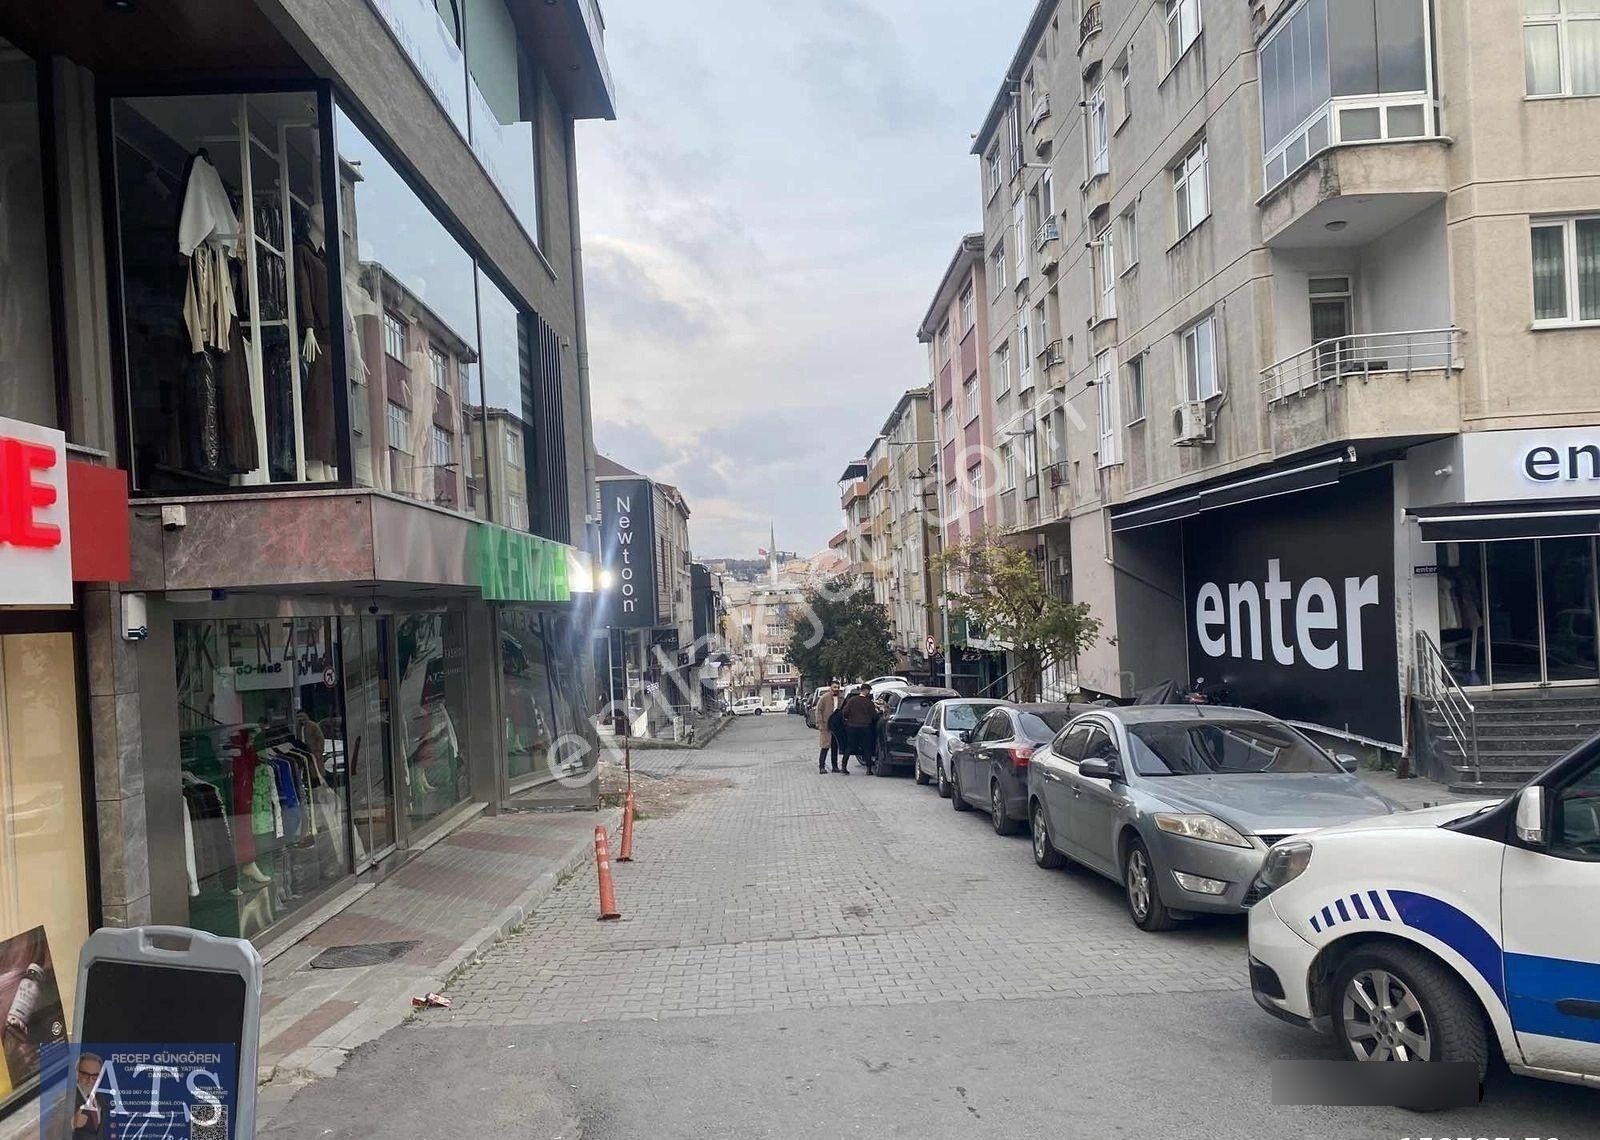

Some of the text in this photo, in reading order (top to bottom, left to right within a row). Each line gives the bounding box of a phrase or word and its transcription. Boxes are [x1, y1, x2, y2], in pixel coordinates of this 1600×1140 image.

[0, 436, 61, 548] E
[1525, 445, 1600, 480] en
[616, 496, 634, 612] Newtoon
[1196, 558, 1379, 671] enter
